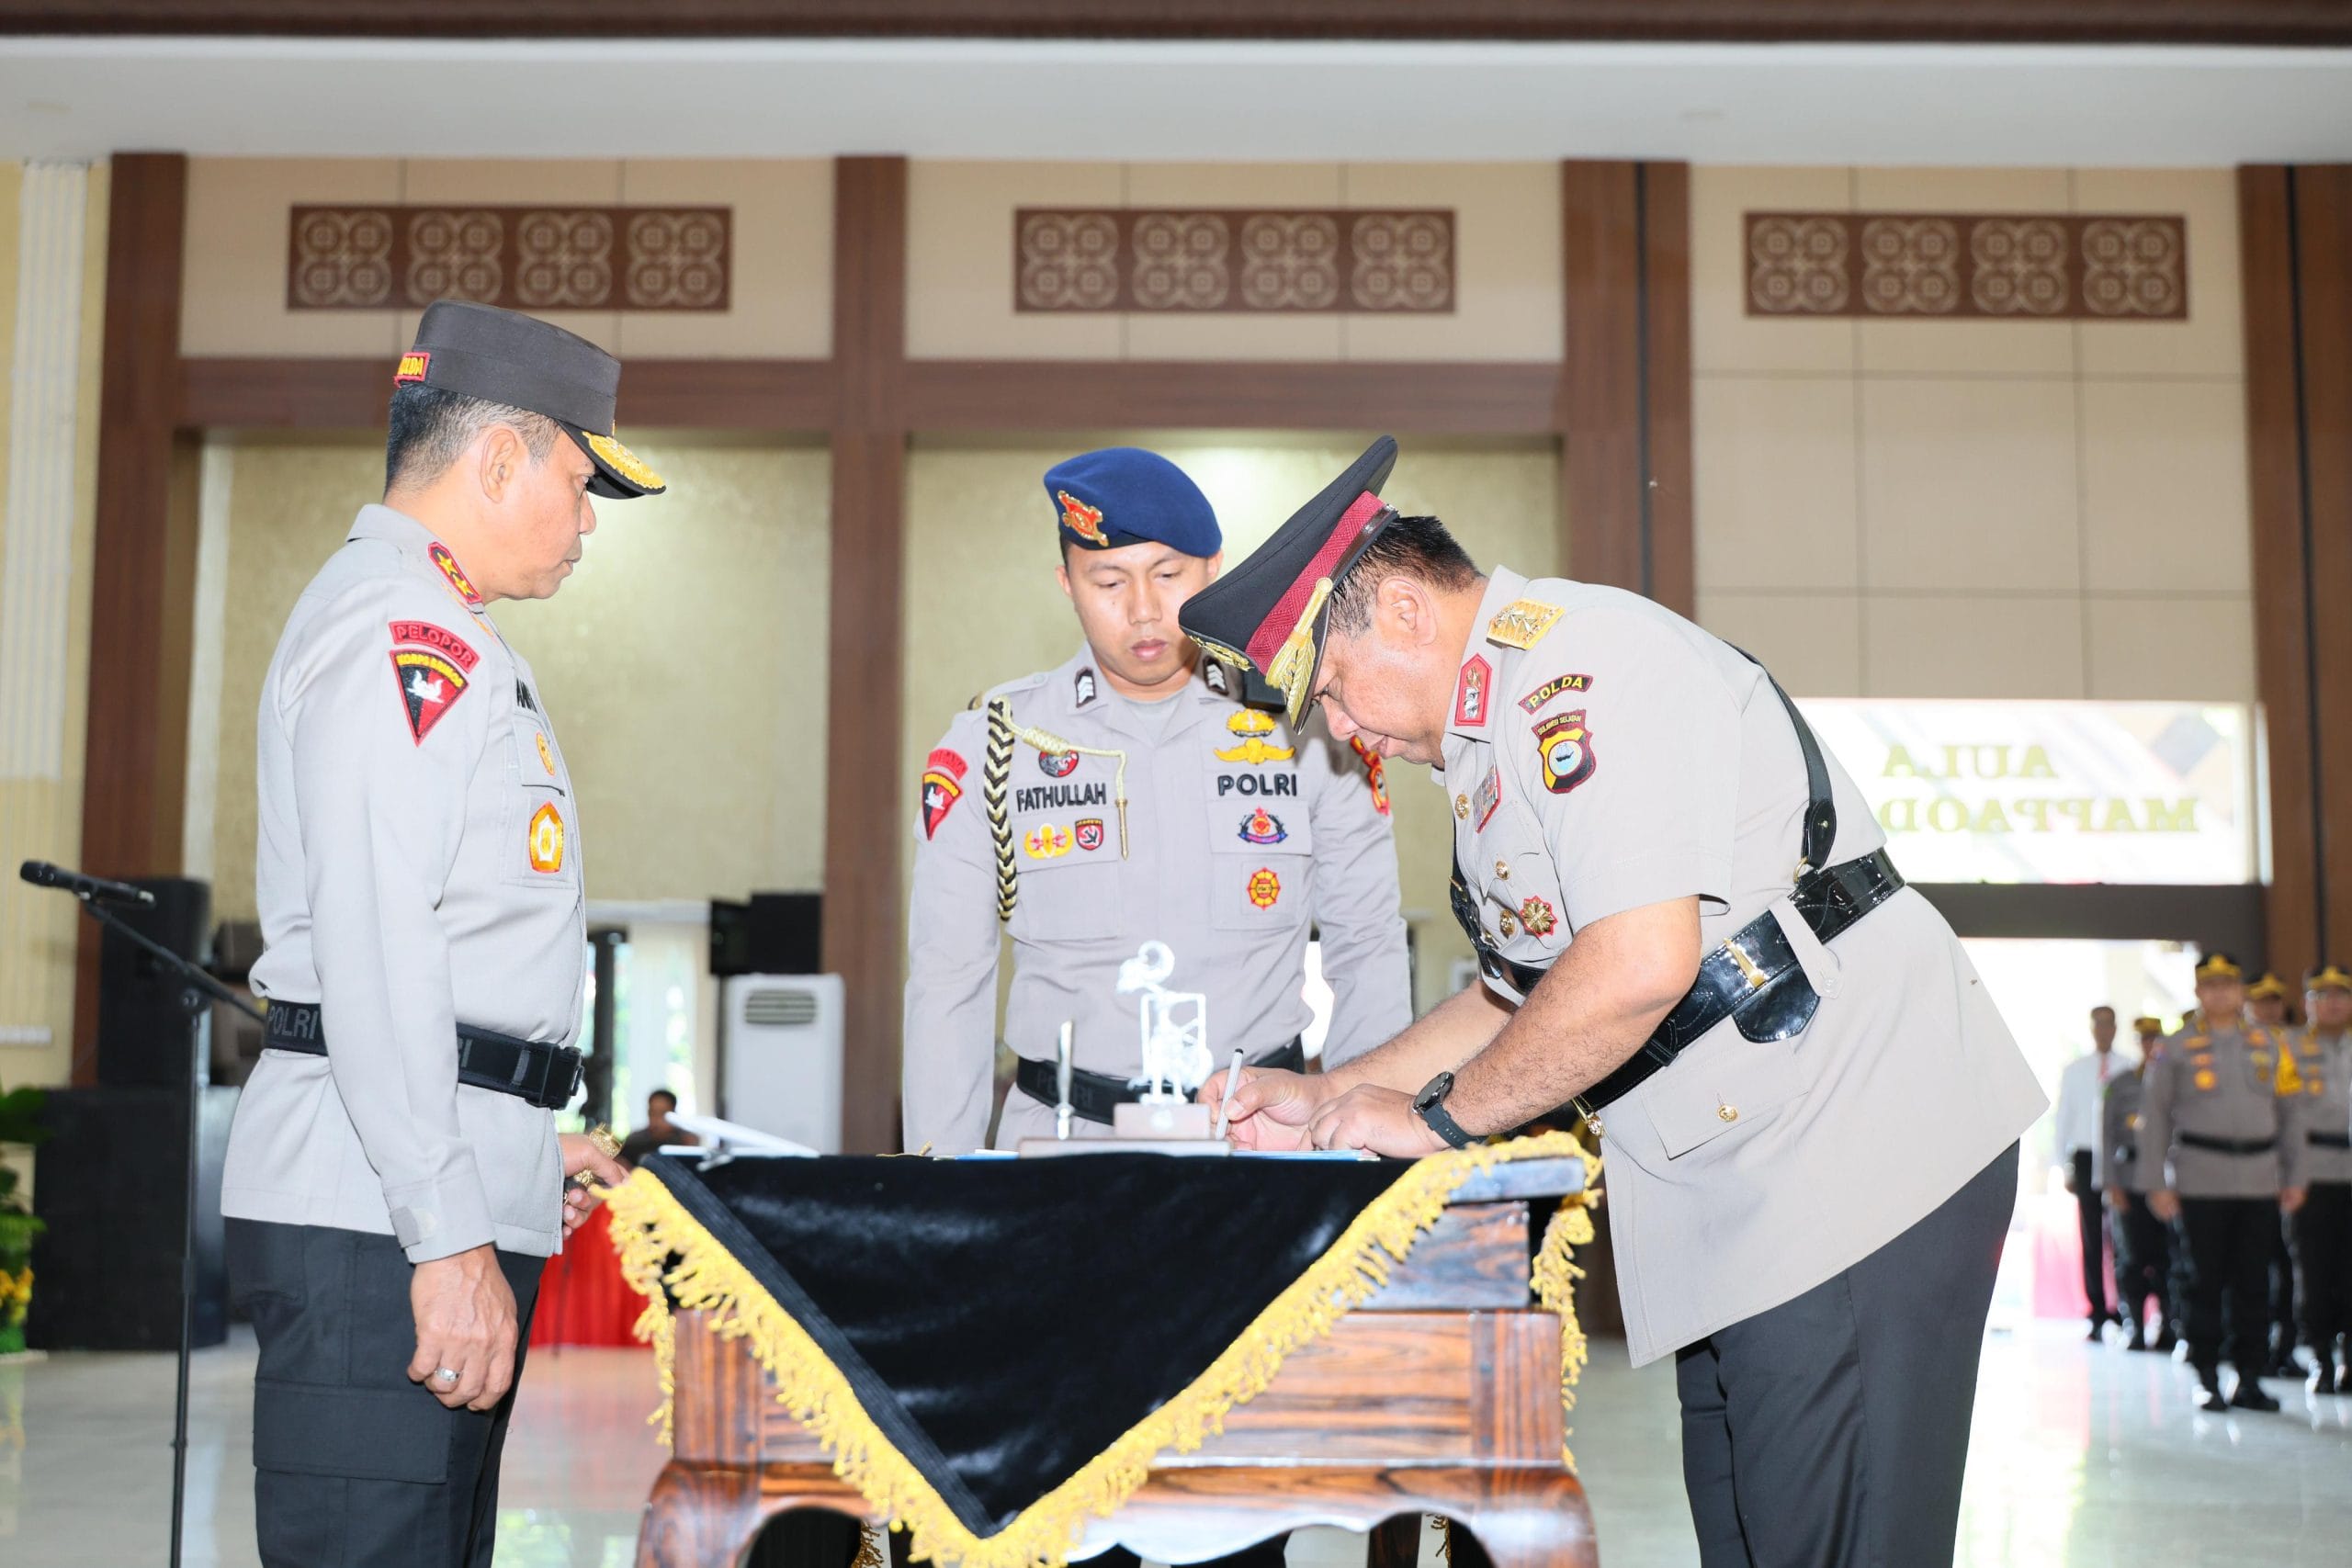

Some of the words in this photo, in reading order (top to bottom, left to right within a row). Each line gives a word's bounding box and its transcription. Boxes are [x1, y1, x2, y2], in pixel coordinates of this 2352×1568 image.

[396, 625, 472, 668] PELOPOR
[1528, 676, 1583, 707] POLDA
[1016, 783, 1107, 813] FATHULLAH
[1217, 773, 1297, 796] POLRI
[268, 1005, 319, 1039] POLRI
[1036, 1068, 1095, 1110] PORI
